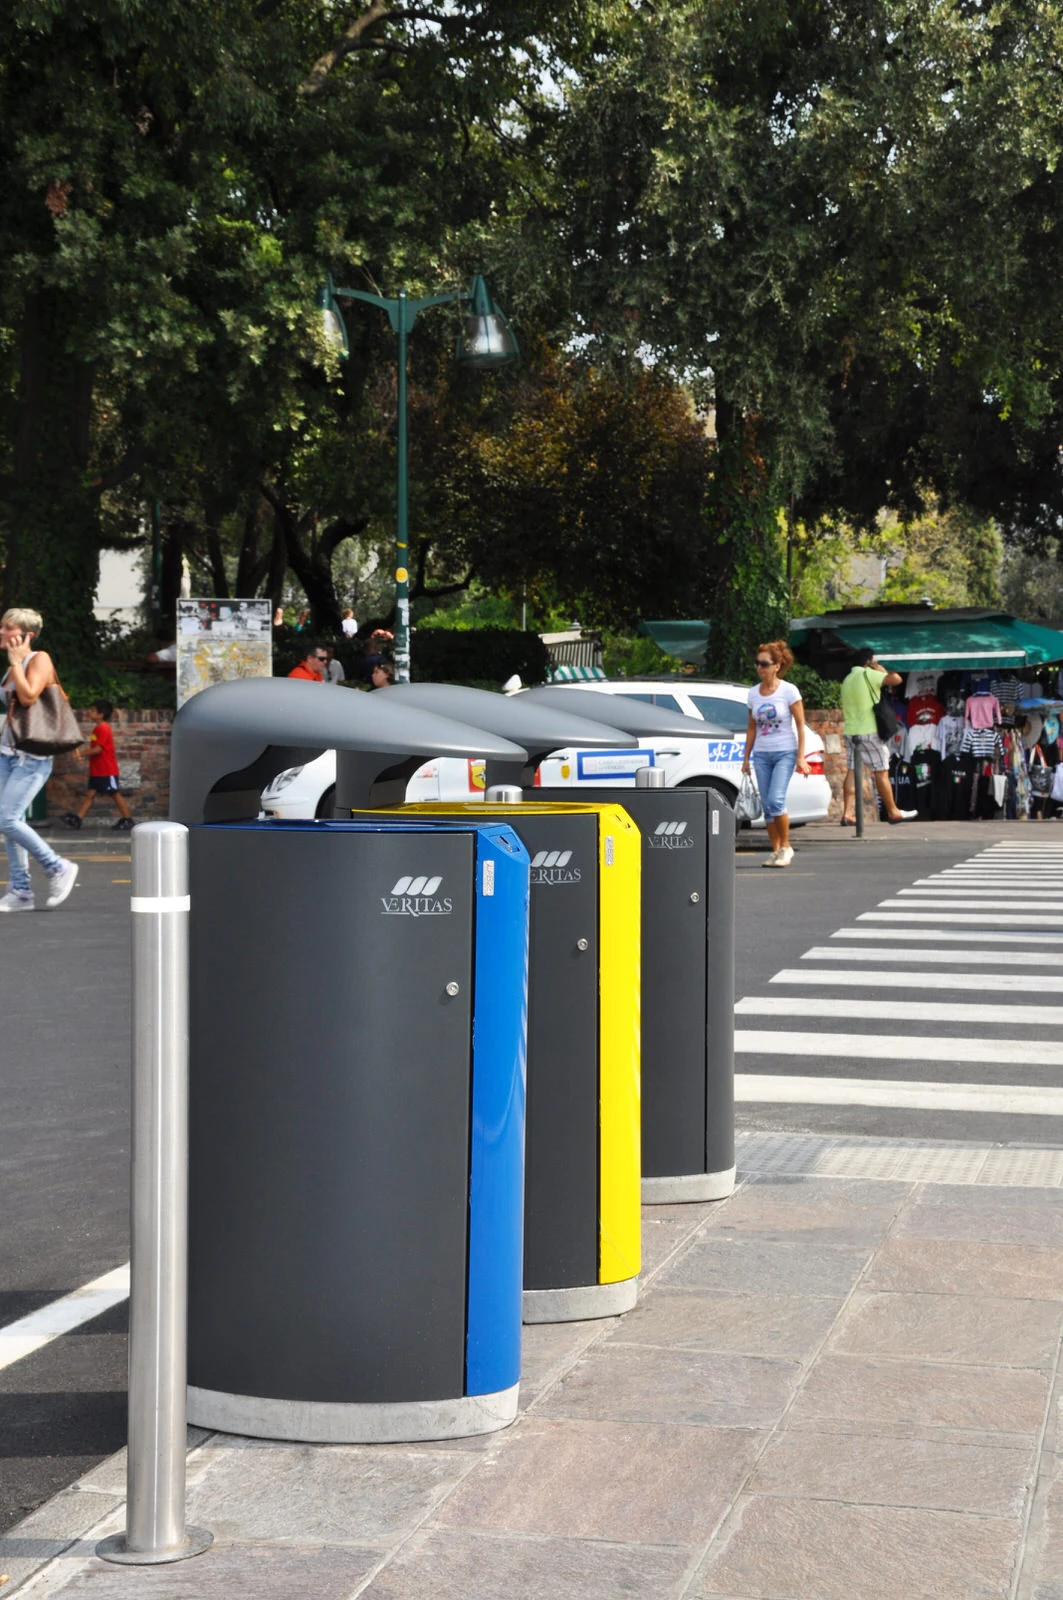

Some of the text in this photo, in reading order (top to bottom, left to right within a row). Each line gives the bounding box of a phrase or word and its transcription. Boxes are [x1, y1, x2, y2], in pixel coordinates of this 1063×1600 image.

[647, 836, 695, 850] VERITAS
[530, 868, 582, 885] ERITAS
[381, 897, 453, 917] VERITAS
